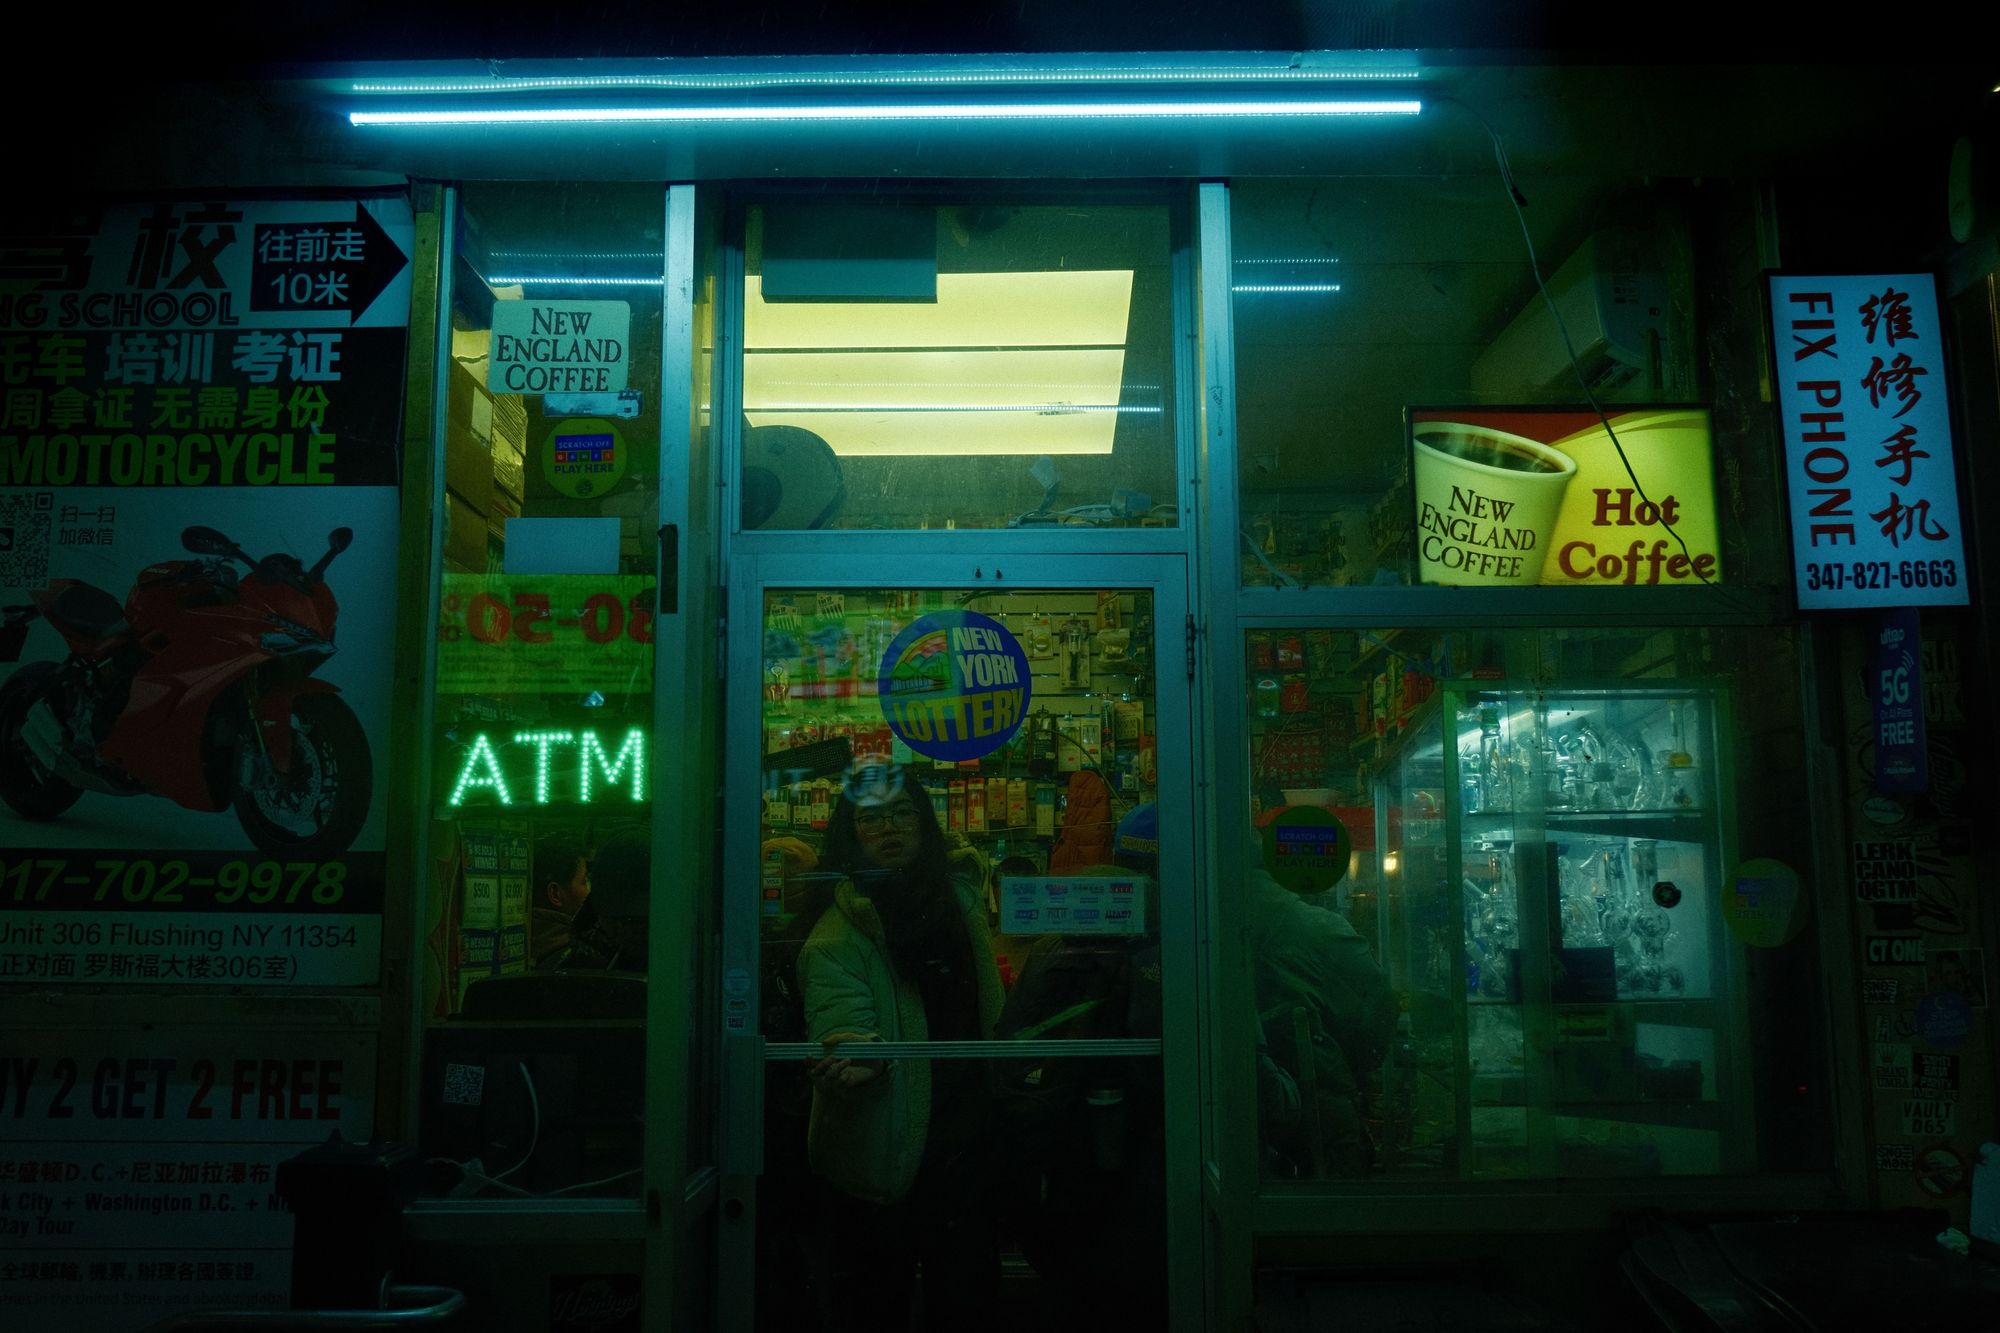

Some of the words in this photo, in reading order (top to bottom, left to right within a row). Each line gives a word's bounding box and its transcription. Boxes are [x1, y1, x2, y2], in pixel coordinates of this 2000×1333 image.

[257, 228, 366, 264] 往前走
[270, 273, 350, 306] 10米
[58, 291, 240, 327] SCHOOL
[1789, 291, 1838, 362] FIX
[104, 332, 214, 384] 培训
[231, 331, 343, 383] 考证
[496, 334, 622, 363] ENGLAND
[504, 364, 610, 391] COFFEE
[149, 385, 331, 430] 无需身份
[1858, 287, 1950, 549] 维修手机
[0, 433, 337, 485] MOTORCYCLE
[554, 465, 581, 474] PLAY
[585, 463, 614, 473] HERE
[1796, 380, 1855, 547] PHONE
[60, 505, 116, 524] 扫一扫
[1591, 487, 1680, 526] Hot
[58, 527, 115, 546] 加微信
[1418, 502, 1537, 551] ENGLAND
[1422, 535, 1524, 578] COFFEE
[1558, 540, 1716, 585] Coffee
[1806, 559, 1957, 591] 347-827-6663
[952, 626, 1003, 652] NEW
[956, 652, 1020, 690] YORK
[1880, 665, 1910, 706] 5G
[892, 686, 1025, 743] LOTTERY
[1880, 720, 1916, 746] FREE
[449, 730, 645, 807] ATM
[0, 858, 347, 904] 17-702-9978
[52, 922, 101, 945] 306
[110, 923, 223, 951] Flushing
[232, 924, 272, 947] NY
[280, 925, 357, 948] 11354
[1, 953, 75, 977] 正对面
[47, 1058, 78, 1119] 2
[91, 1058, 177, 1120] GET
[186, 1059, 215, 1120] 2
[230, 1060, 344, 1121] FREE
[1903, 1100, 1951, 1119] VAULT
[1911, 1118, 1946, 1135] D65
[18, 1192, 53, 1215] City
[84, 1192, 193, 1215] Washington
[198, 1192, 237, 1212] D.C.
[36, 1216, 75, 1235] Tour
